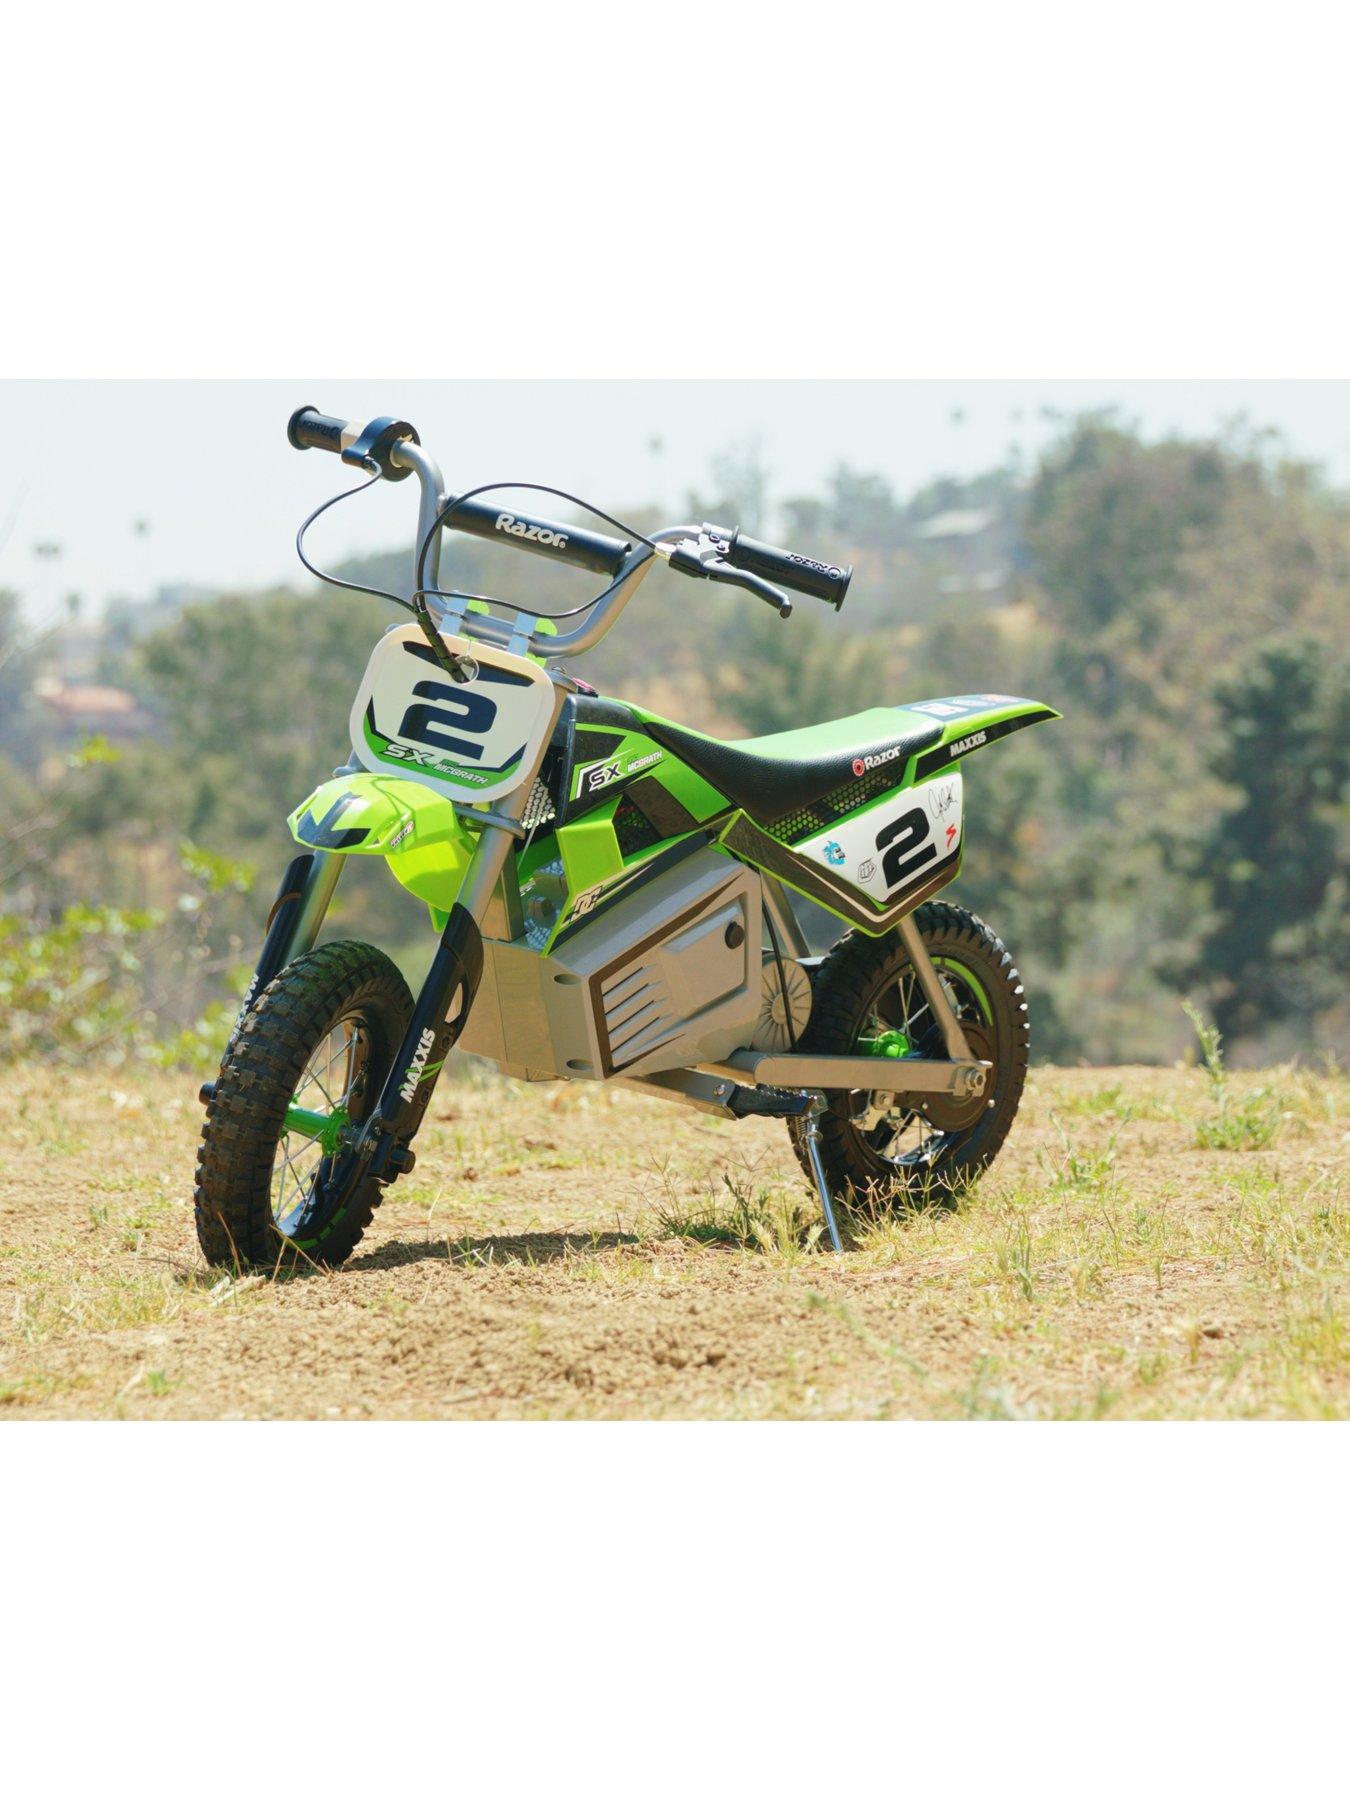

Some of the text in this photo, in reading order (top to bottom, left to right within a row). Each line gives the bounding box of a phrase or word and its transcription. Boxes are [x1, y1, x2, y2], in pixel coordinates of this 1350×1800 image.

[397, 680, 498, 761] 2
[384, 743, 432, 767] SX
[863, 746, 901, 770] Razor
[950, 731, 987, 757] MAXXIS
[588, 761, 625, 792] SX
[875, 807, 938, 889] 2
[399, 1027, 436, 1104] MAXXIS
